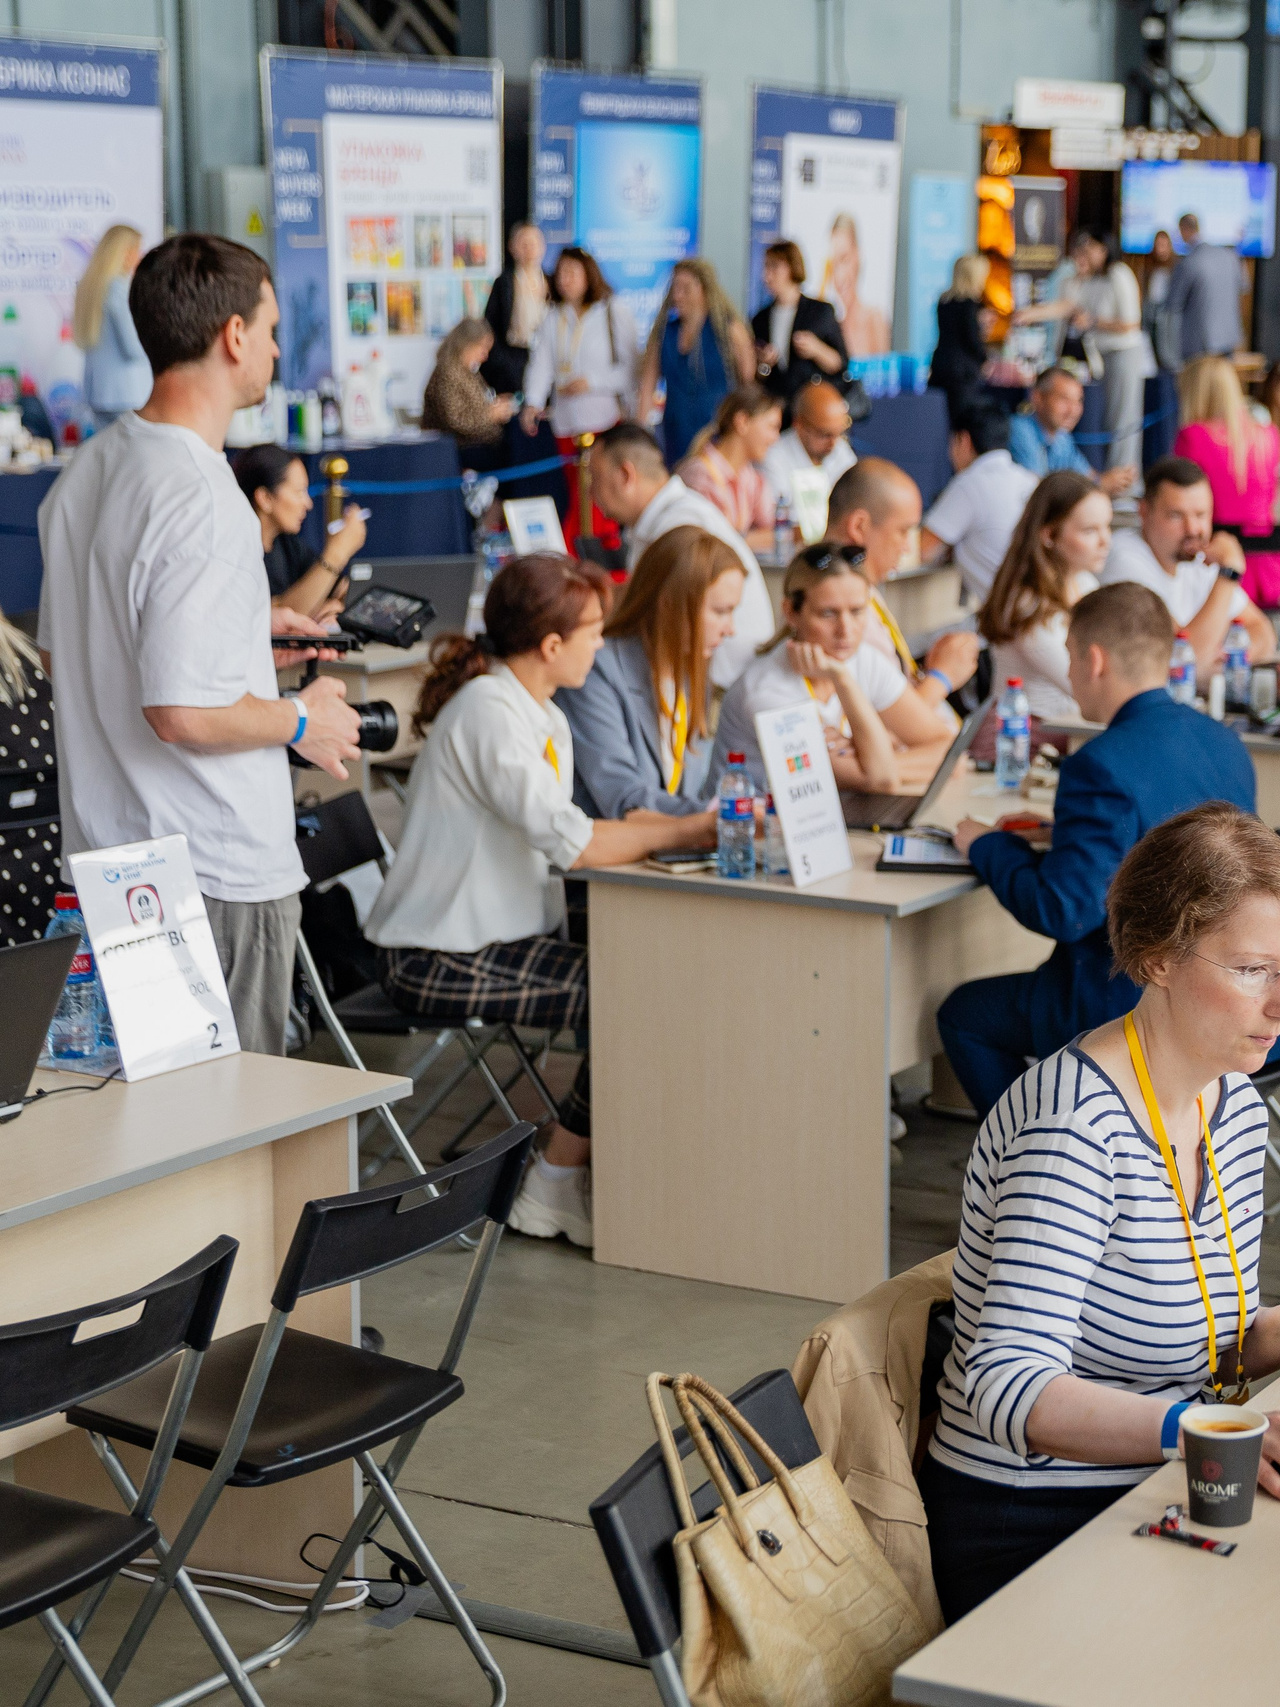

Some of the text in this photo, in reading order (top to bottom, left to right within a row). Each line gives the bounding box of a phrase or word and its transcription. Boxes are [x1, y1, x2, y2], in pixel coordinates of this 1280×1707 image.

[801, 854, 812, 877] 5
[207, 1022, 222, 1049] 2
[1191, 1478, 1239, 1496] AROME
